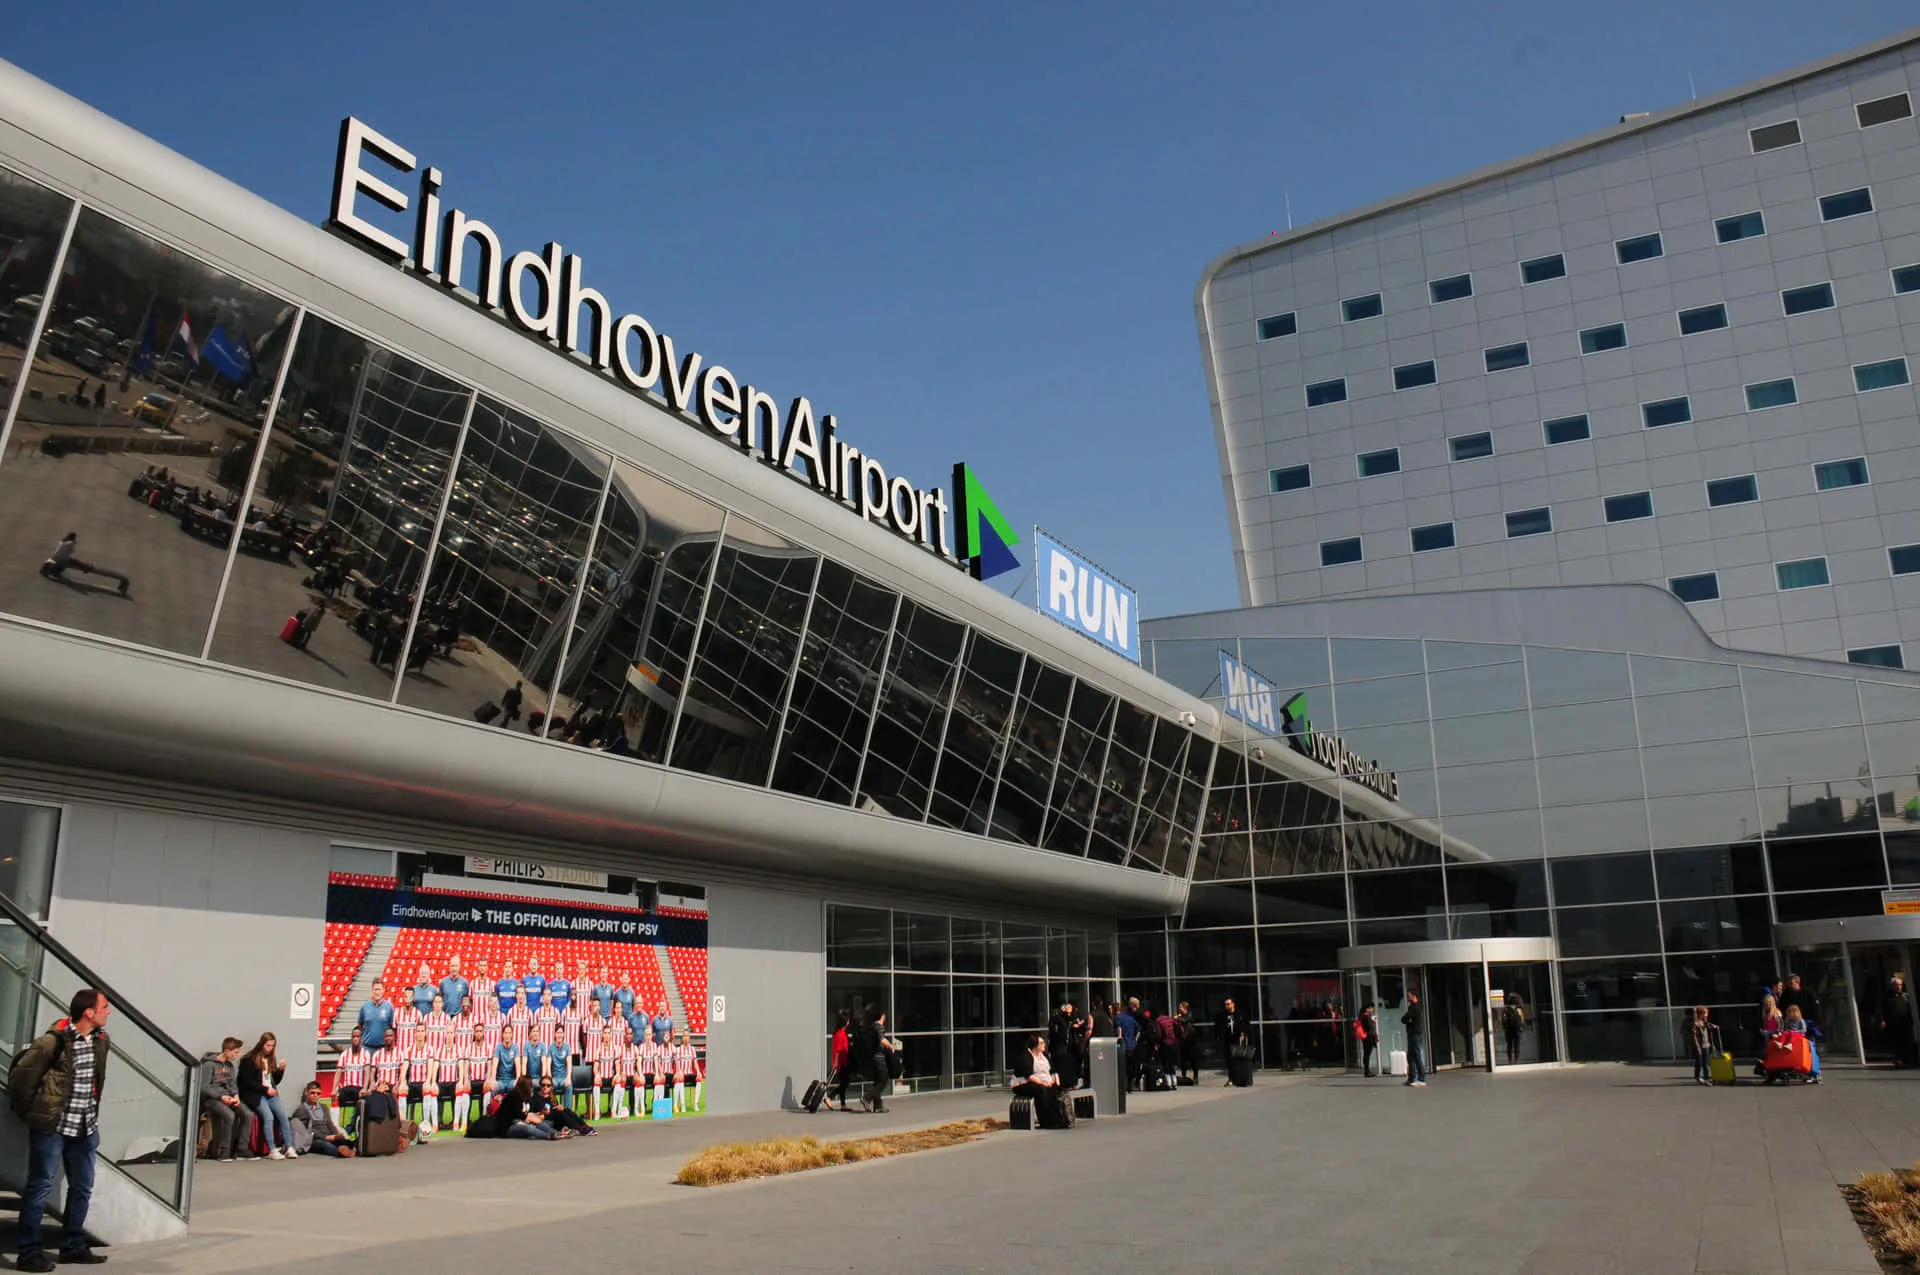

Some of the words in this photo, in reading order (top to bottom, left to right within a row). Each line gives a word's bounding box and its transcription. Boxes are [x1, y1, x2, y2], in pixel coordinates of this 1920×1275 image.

[331, 114, 950, 557] EindhovenAirport
[1050, 549, 1129, 650] RUN
[494, 859, 546, 879] PHILIPS
[391, 903, 470, 922] EindhovenAirport
[485, 909, 512, 924] THE
[513, 911, 569, 930] OFFICIAL
[570, 917, 621, 934] AIRPORT
[622, 920, 637, 934] OF
[638, 922, 659, 936] PSV
